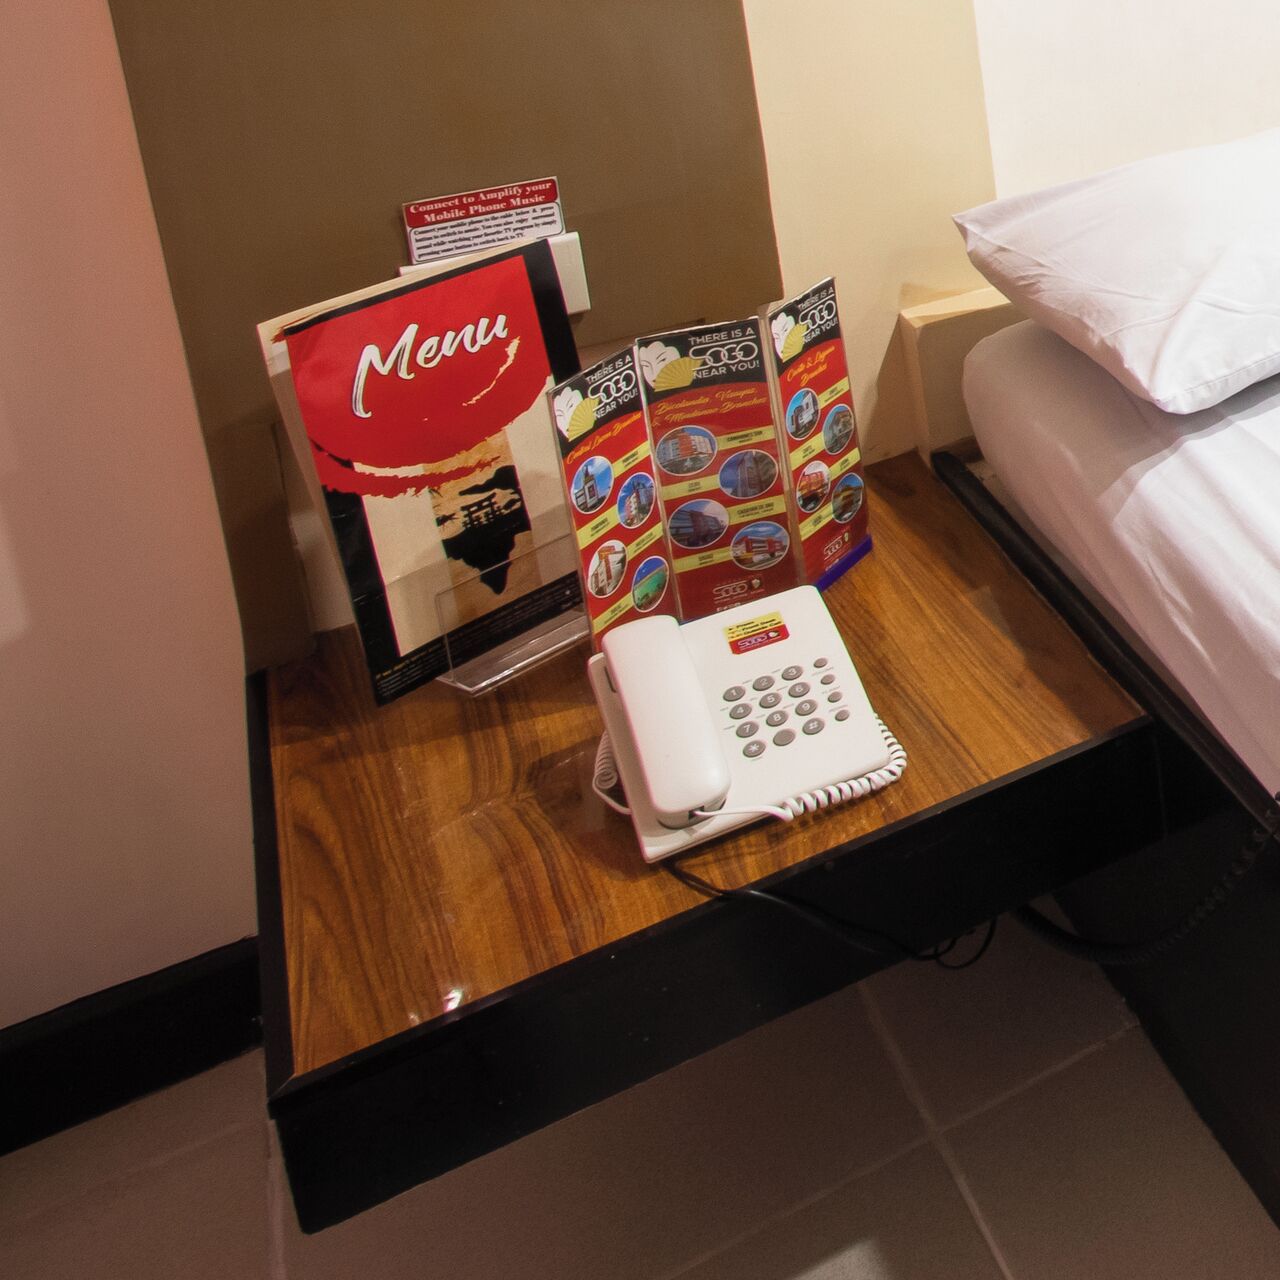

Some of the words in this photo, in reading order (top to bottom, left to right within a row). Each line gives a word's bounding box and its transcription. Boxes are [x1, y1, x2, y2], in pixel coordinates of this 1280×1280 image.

[410, 198, 459, 214] Connect
[463, 195, 475, 205] to
[477, 186, 523, 202] Amplify
[525, 182, 552, 195] your
[424, 208, 466, 223] Mobile
[469, 201, 507, 215] Phone
[510, 194, 546, 207] Music
[799, 294, 820, 310] THERE
[820, 290, 827, 299] IS
[799, 294, 836, 336] SOGO
[821, 318, 838, 332] YOU!
[688, 331, 729, 345] THERE
[731, 328, 742, 338] IS
[745, 327, 755, 336] A
[352, 314, 509, 418] Menu
[689, 335, 758, 371] SOGO
[586, 364, 613, 384] THERE
[615, 358, 624, 370] IS
[625, 355, 632, 364] A
[693, 367, 727, 379] NEAR
[730, 360, 760, 373] YOU!
[588, 363, 636, 411] SOGO
[595, 401, 617, 418] NEAR
[618, 388, 639, 405] YOU!
